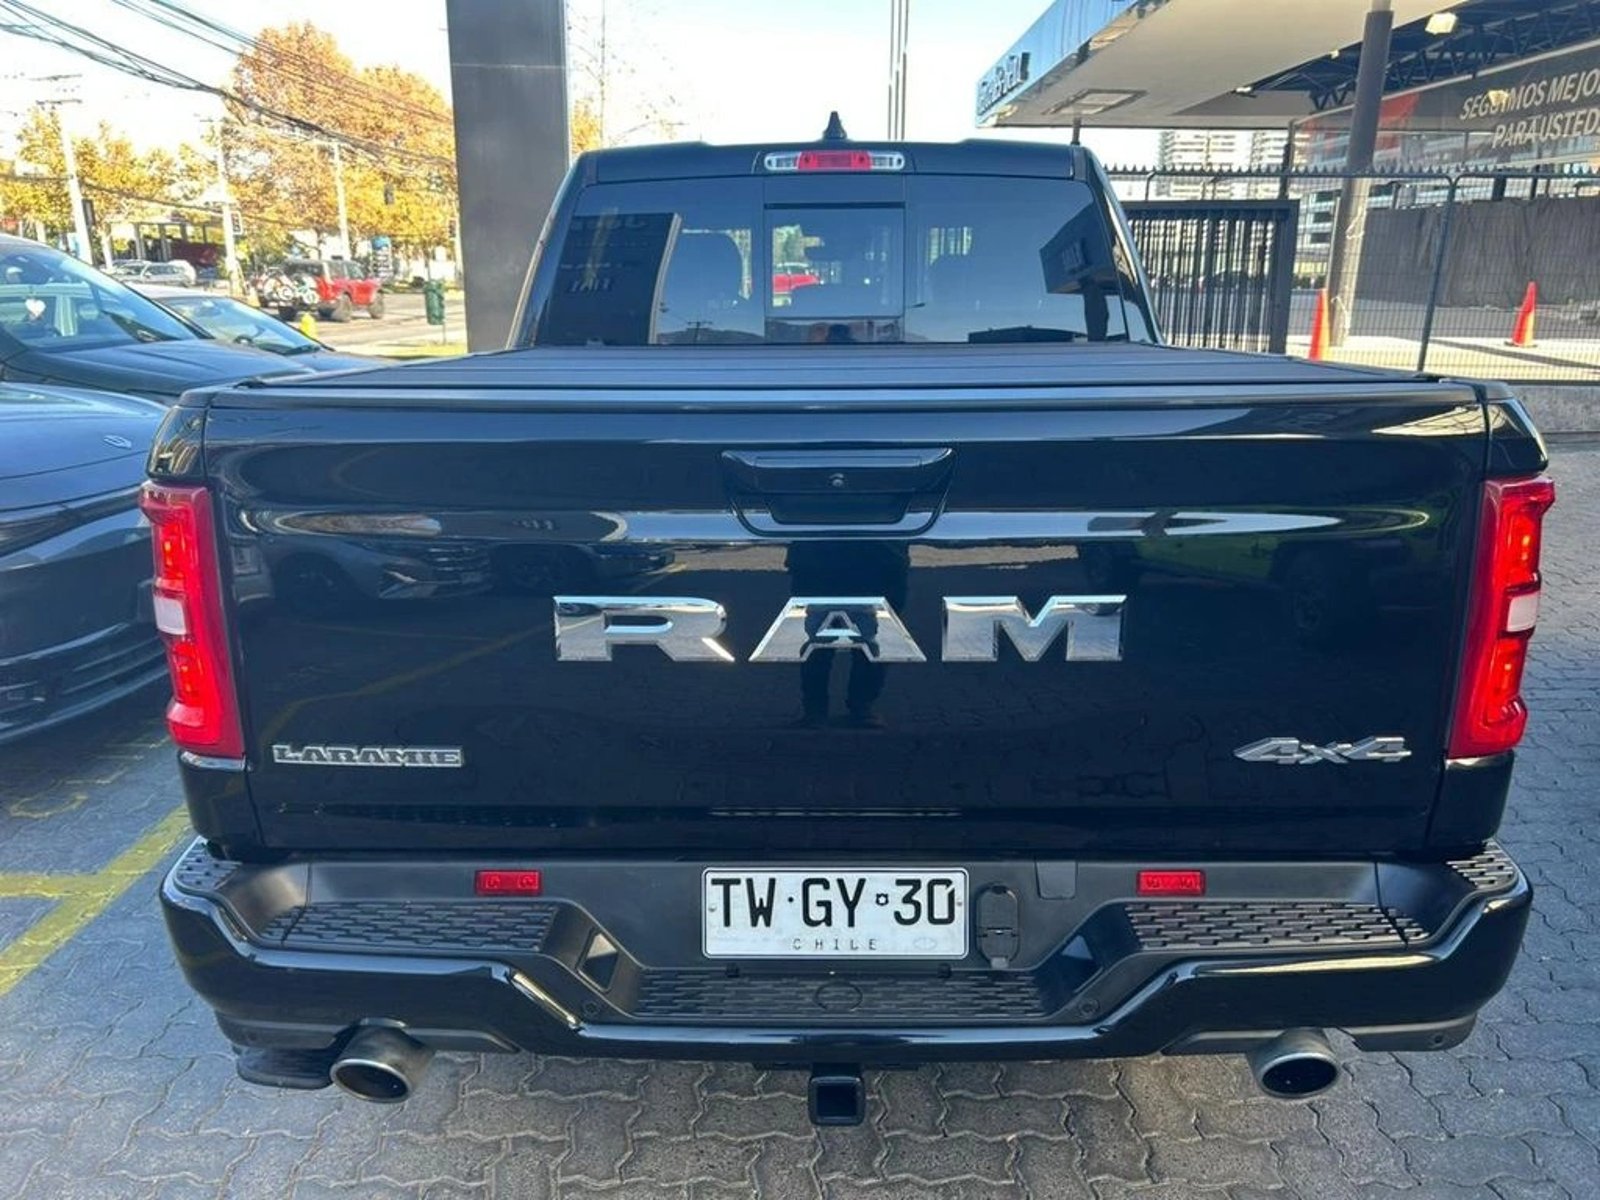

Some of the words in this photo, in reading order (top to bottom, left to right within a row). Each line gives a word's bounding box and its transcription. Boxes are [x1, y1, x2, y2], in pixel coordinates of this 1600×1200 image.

[1546, 68, 1600, 104] MEJO
[1491, 116, 1541, 149] PARA
[1539, 107, 1600, 142] USTED
[553, 595, 1127, 662] RAM
[272, 744, 464, 767] LARAMIE
[711, 878, 776, 927] TW
[802, 878, 866, 927] GY
[894, 878, 955, 926] 30
[793, 938, 877, 951] CHILE
